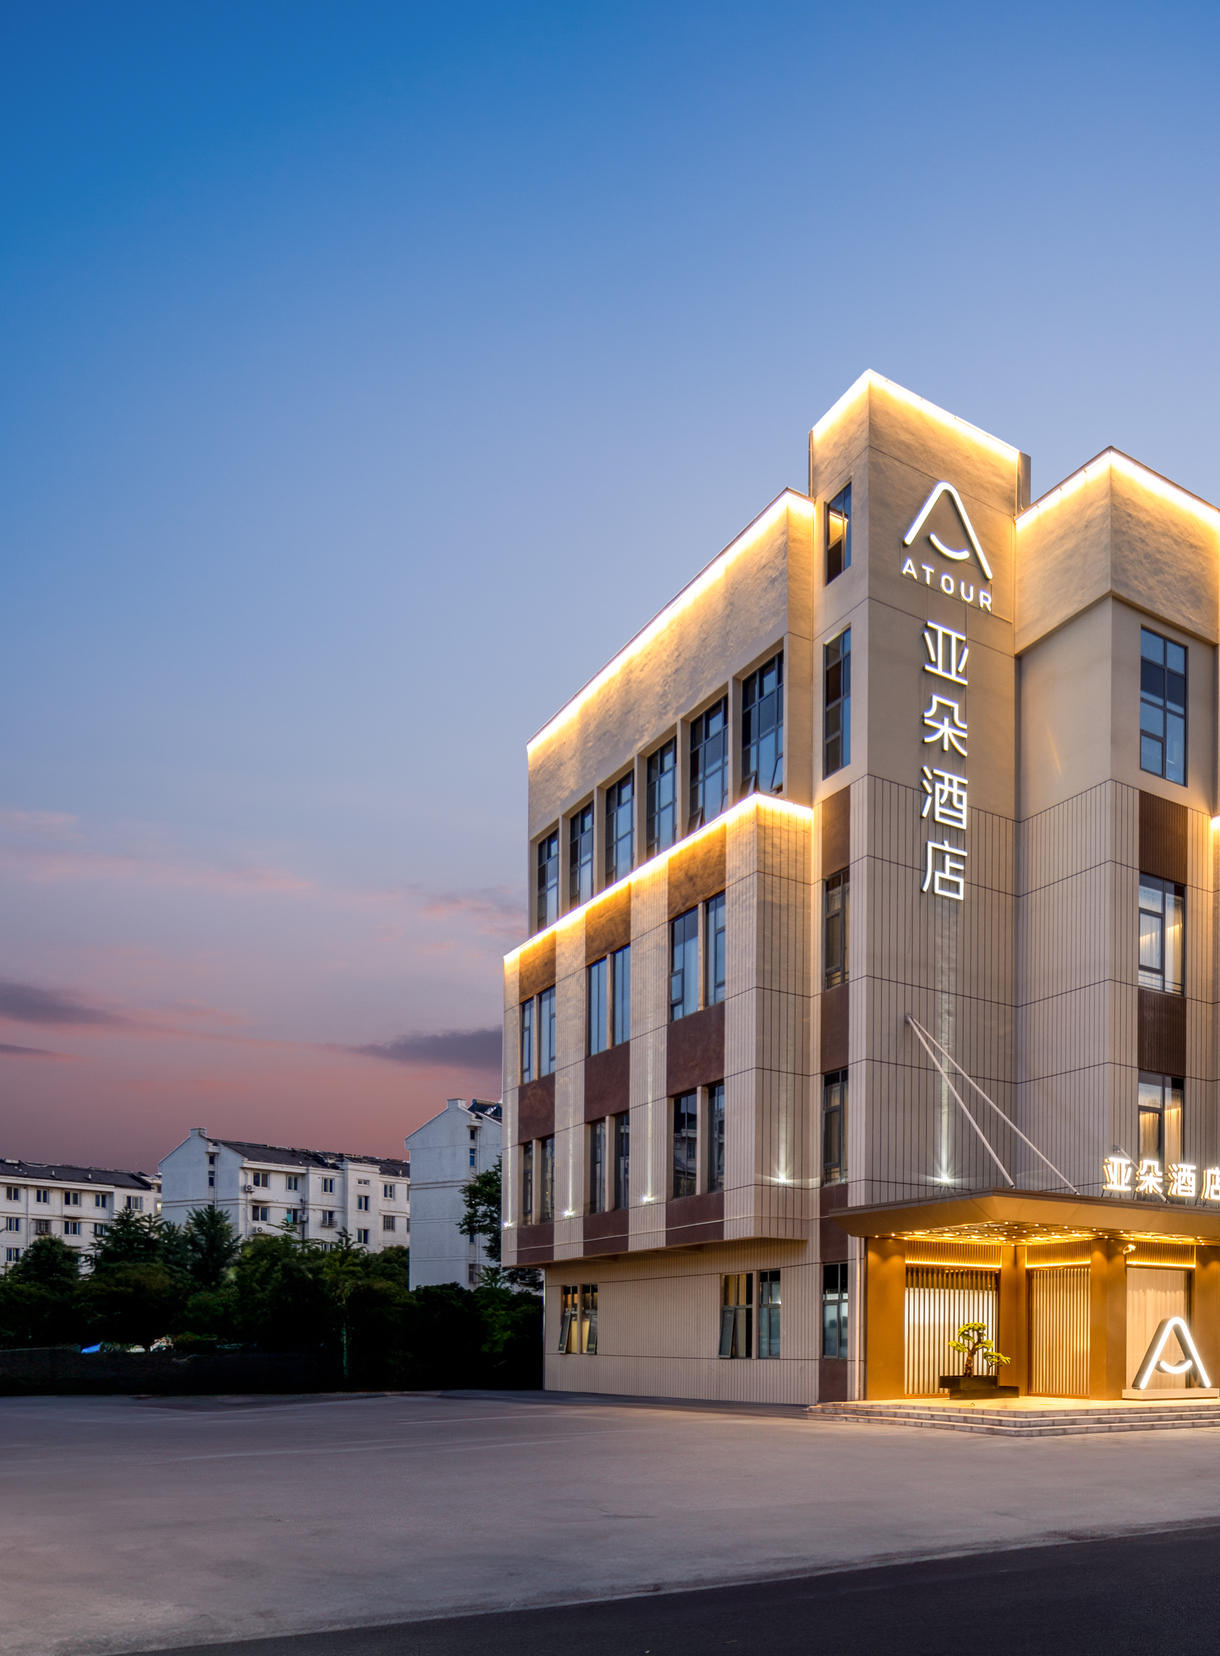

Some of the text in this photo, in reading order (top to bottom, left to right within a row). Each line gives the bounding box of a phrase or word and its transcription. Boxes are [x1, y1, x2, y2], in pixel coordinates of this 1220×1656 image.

[902, 557, 992, 612] ATOUR
[923, 620, 969, 901] 亚朵酒店
